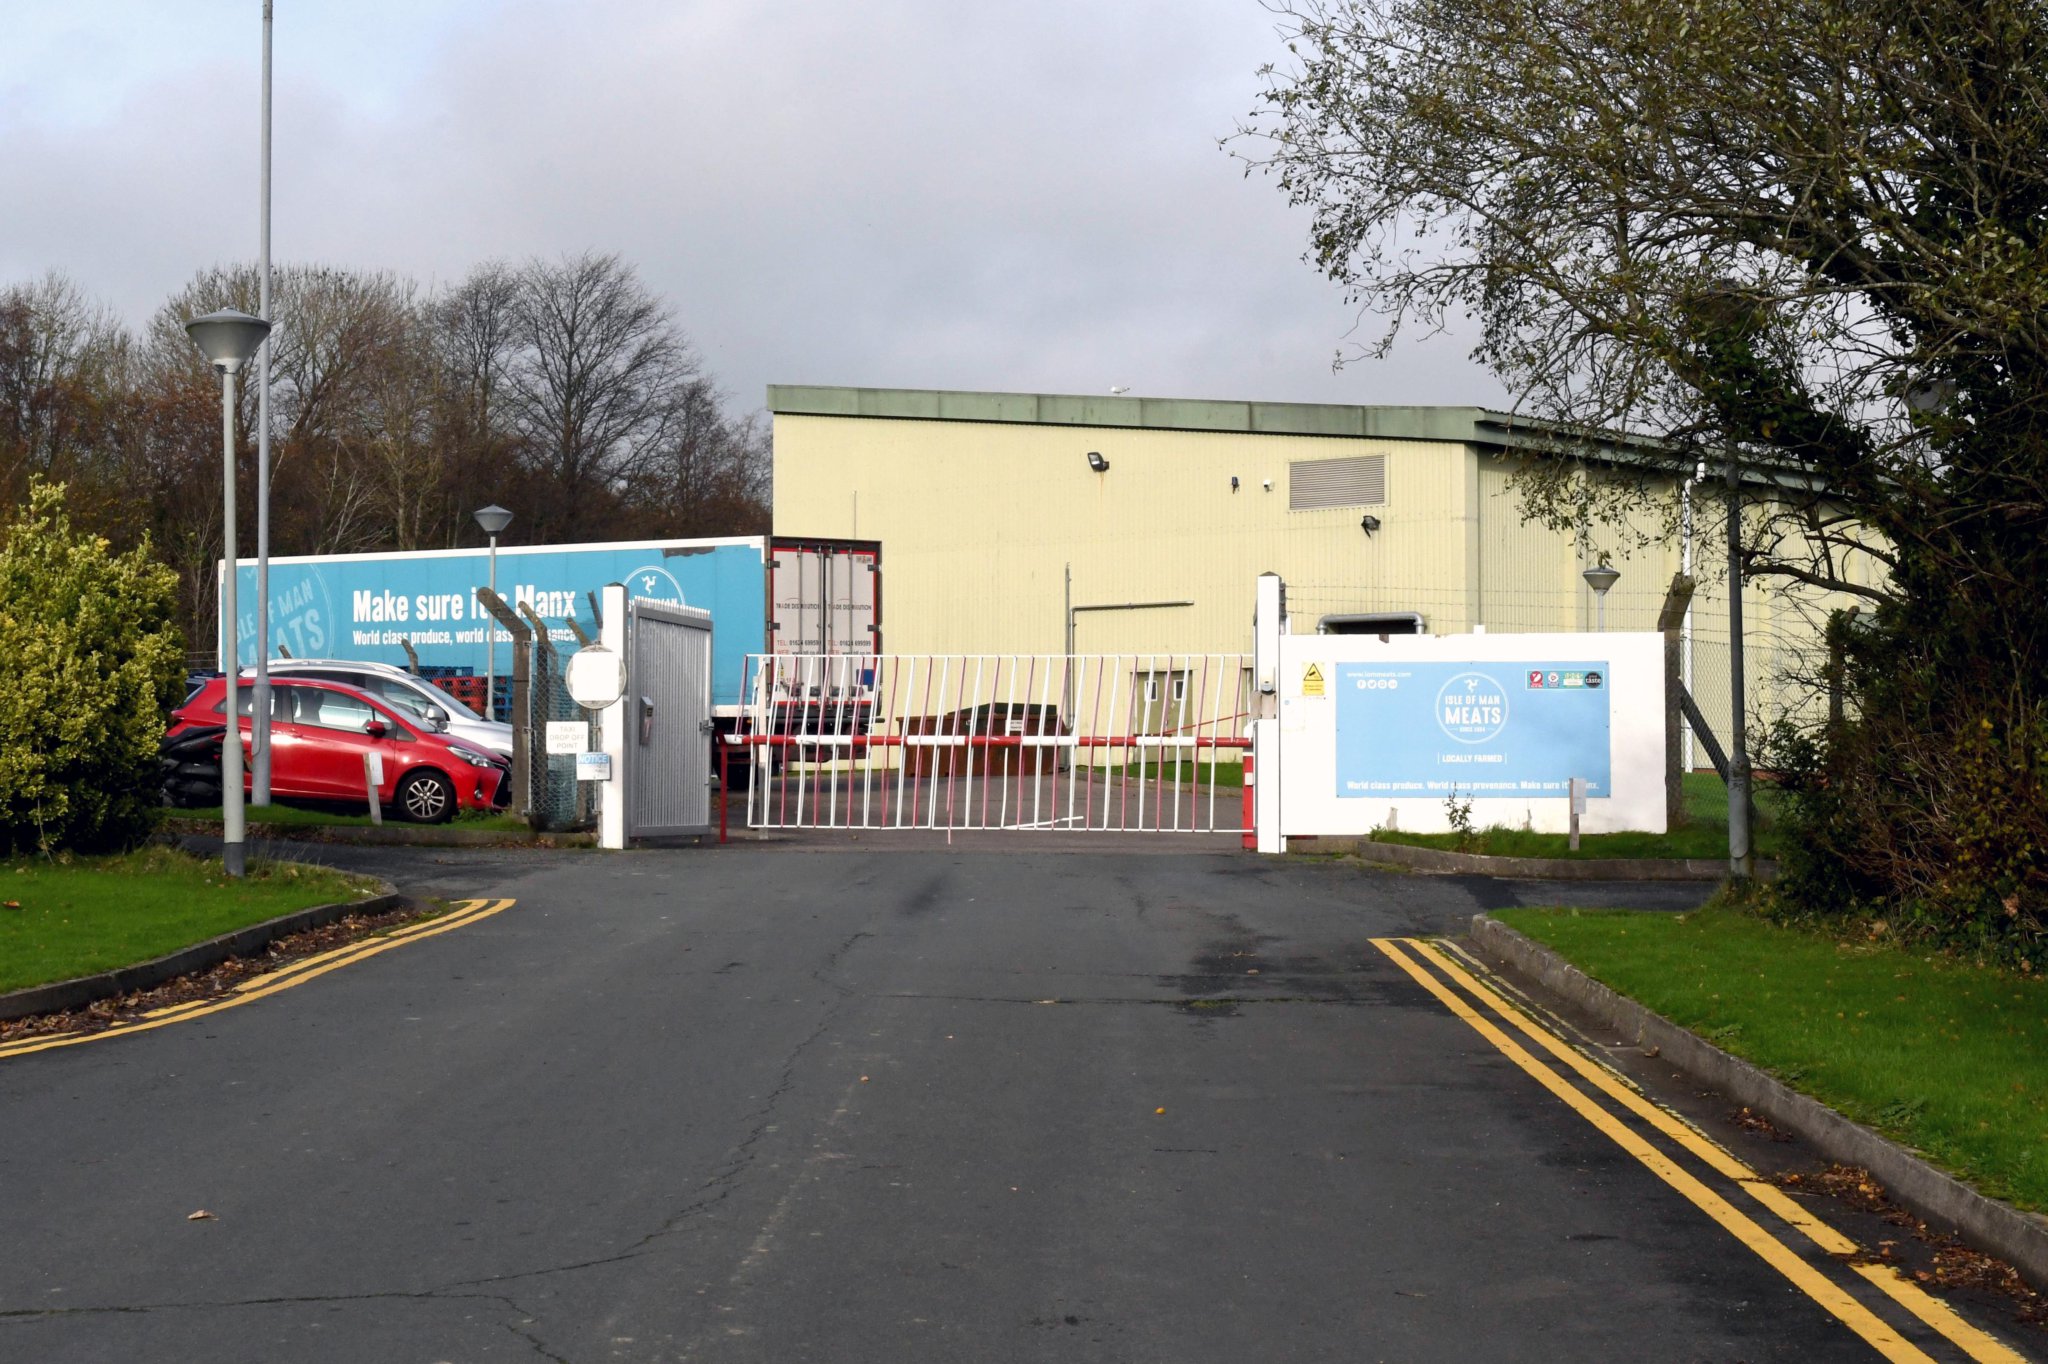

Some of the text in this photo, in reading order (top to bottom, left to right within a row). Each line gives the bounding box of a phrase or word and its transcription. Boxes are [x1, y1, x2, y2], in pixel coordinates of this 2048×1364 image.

[278, 578, 314, 617] MAN
[353, 590, 408, 622] Make
[415, 592, 464, 621] sure
[515, 584, 576, 618] Manx
[353, 629, 379, 645] World
[382, 629, 408, 645] class
[411, 628, 453, 647] produce,
[456, 627, 484, 643] world
[1445, 695, 1500, 704] ISLE OF MAN
[1445, 707, 1501, 724] MEATS
[578, 755, 608, 764] NOTICE
[1442, 754, 1472, 763] LOCALLY
[1346, 781, 1369, 790] World
[1370, 781, 1391, 790] class
[1427, 781, 1448, 790] World
[1520, 781, 1541, 790] Make
[1543, 782, 1560, 790] sure
